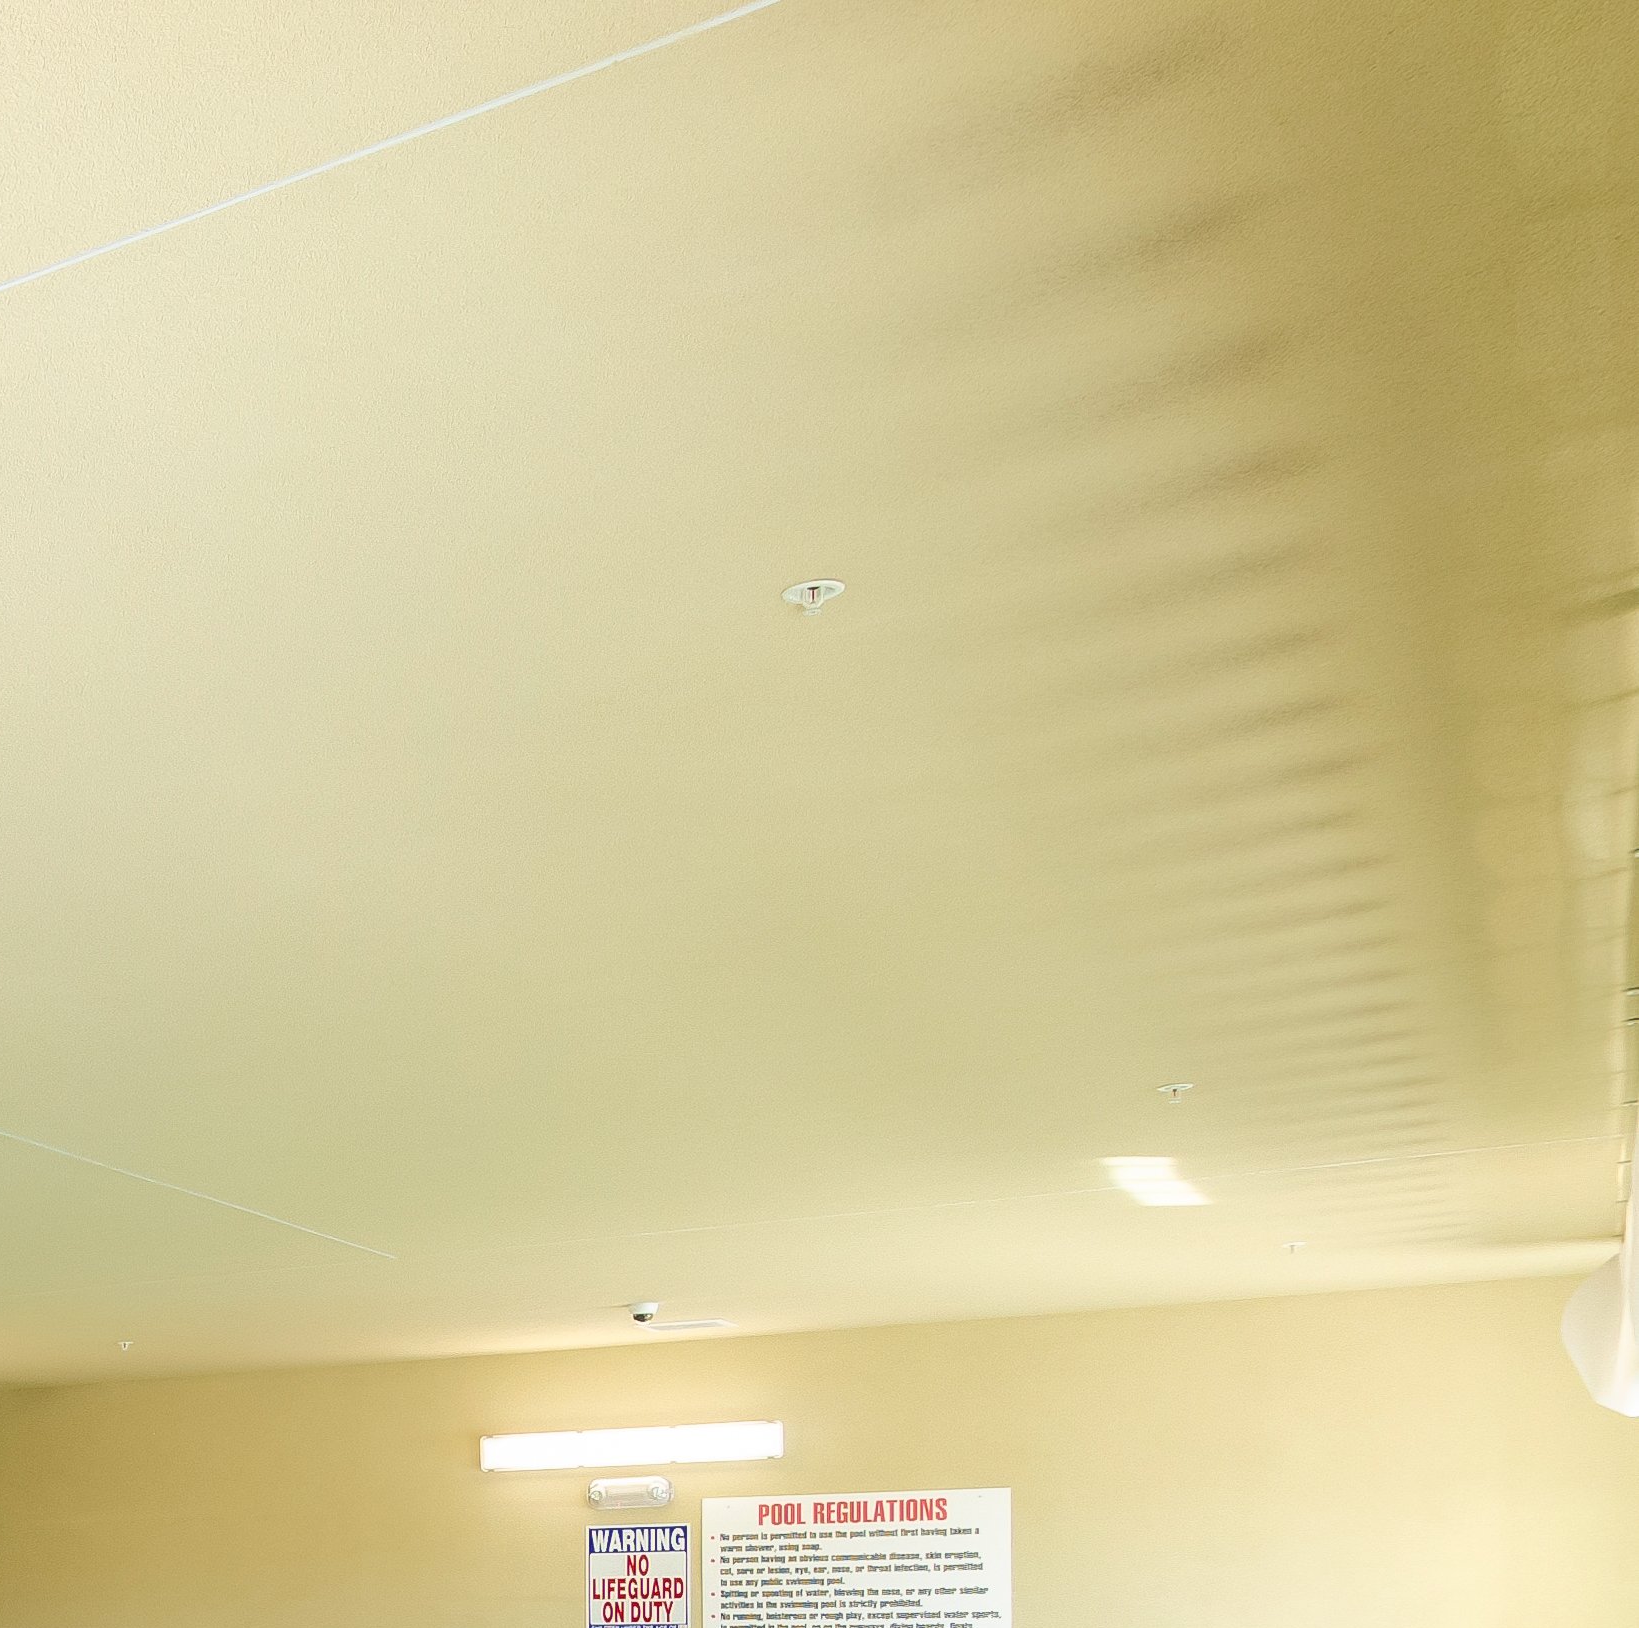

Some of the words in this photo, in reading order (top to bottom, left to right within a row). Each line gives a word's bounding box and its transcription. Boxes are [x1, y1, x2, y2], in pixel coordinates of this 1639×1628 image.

[758, 1503, 806, 1525] POOL
[813, 1498, 948, 1524] REGULATIONS
[591, 1528, 685, 1552] WARNING
[627, 1555, 649, 1576] NO
[592, 1577, 684, 1600] LIFEGUARD
[603, 1602, 625, 1623] ON
[631, 1601, 673, 1623] DUTY
